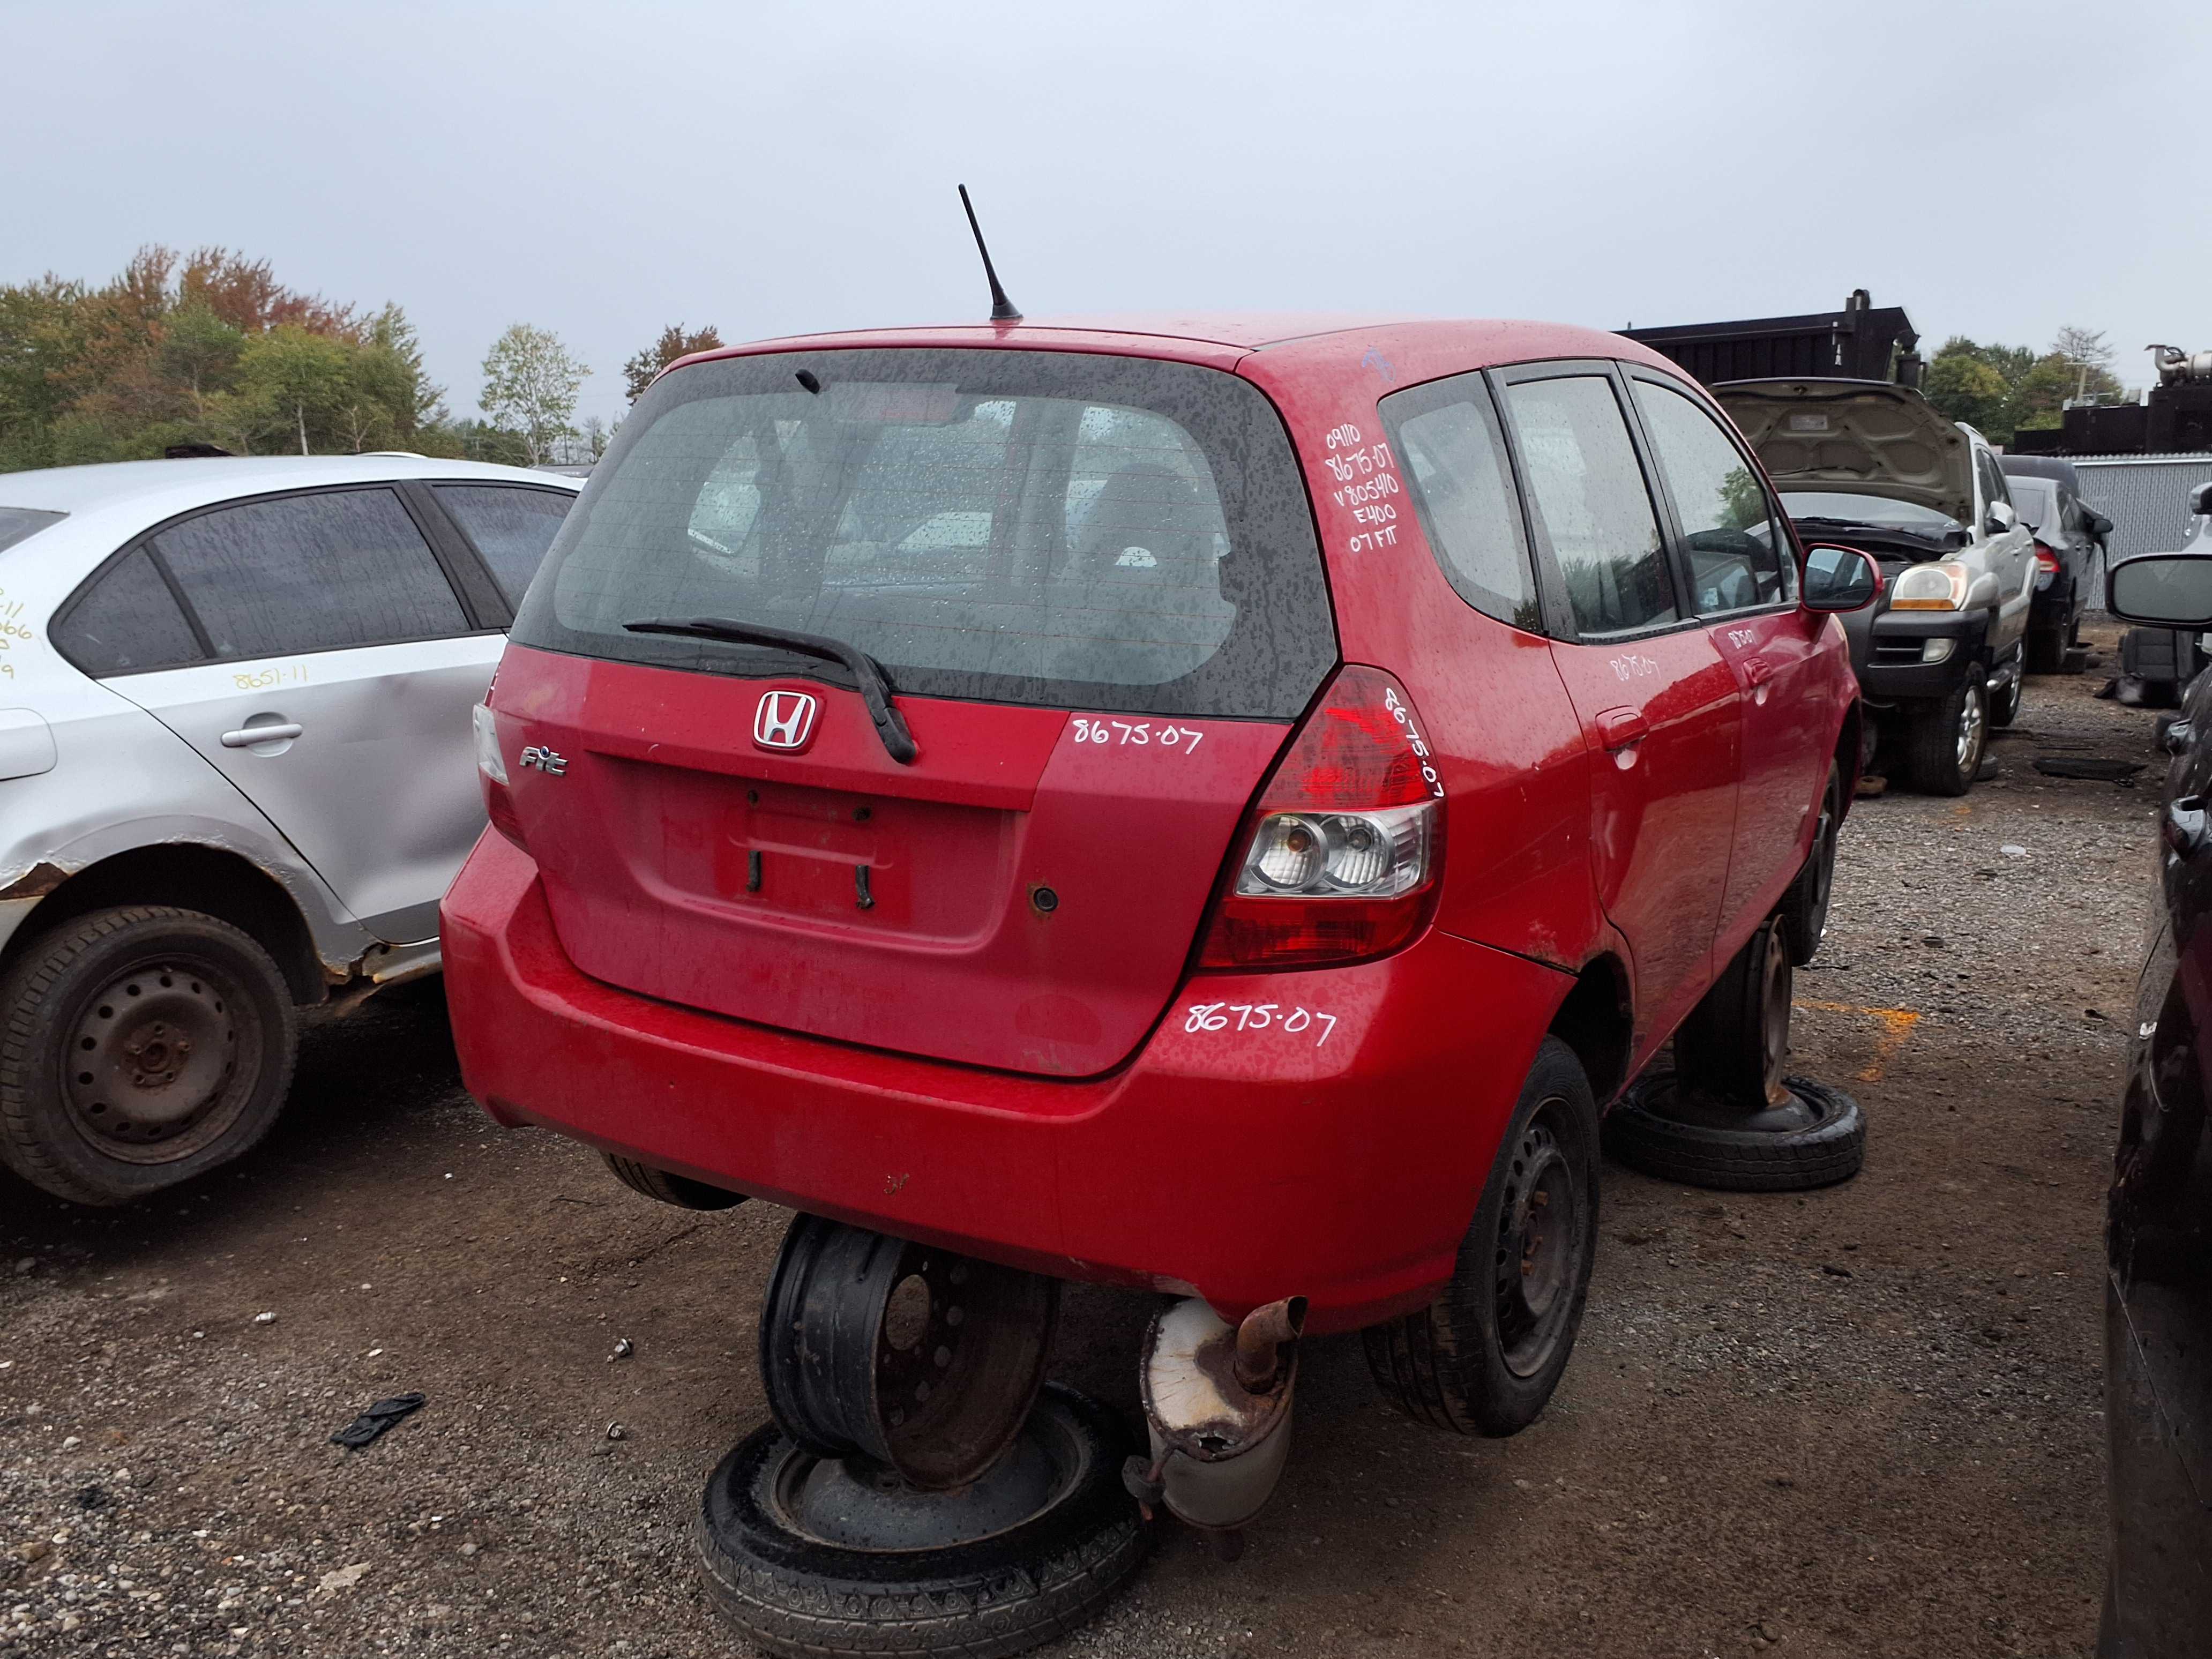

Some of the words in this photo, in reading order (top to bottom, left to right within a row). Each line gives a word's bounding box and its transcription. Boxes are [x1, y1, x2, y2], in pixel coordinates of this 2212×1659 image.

[1353, 504, 1397, 525] E400
[1350, 533, 1373, 552] 07
[1374, 525, 1397, 547] FIT
